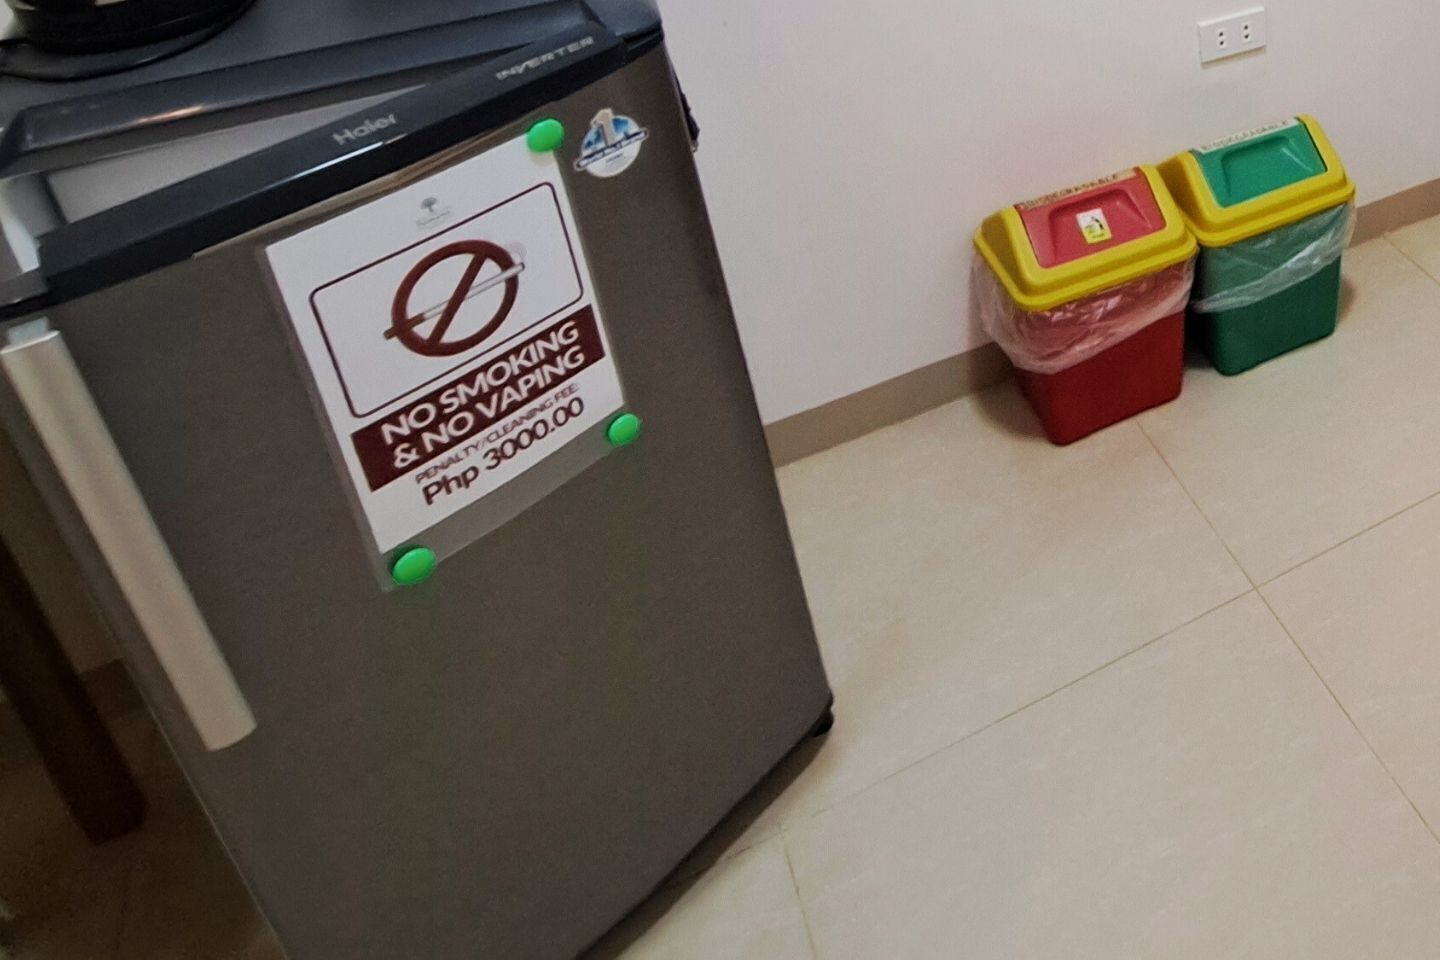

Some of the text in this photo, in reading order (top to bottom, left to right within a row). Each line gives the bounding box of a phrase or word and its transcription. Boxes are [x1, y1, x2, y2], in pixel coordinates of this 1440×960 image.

[496, 36, 595, 81] INVERTER
[332, 113, 398, 146] Haier
[381, 320, 579, 446] NO SMOKING
[392, 344, 585, 470] & NO VAPING
[421, 396, 585, 506] Php 3000.00
